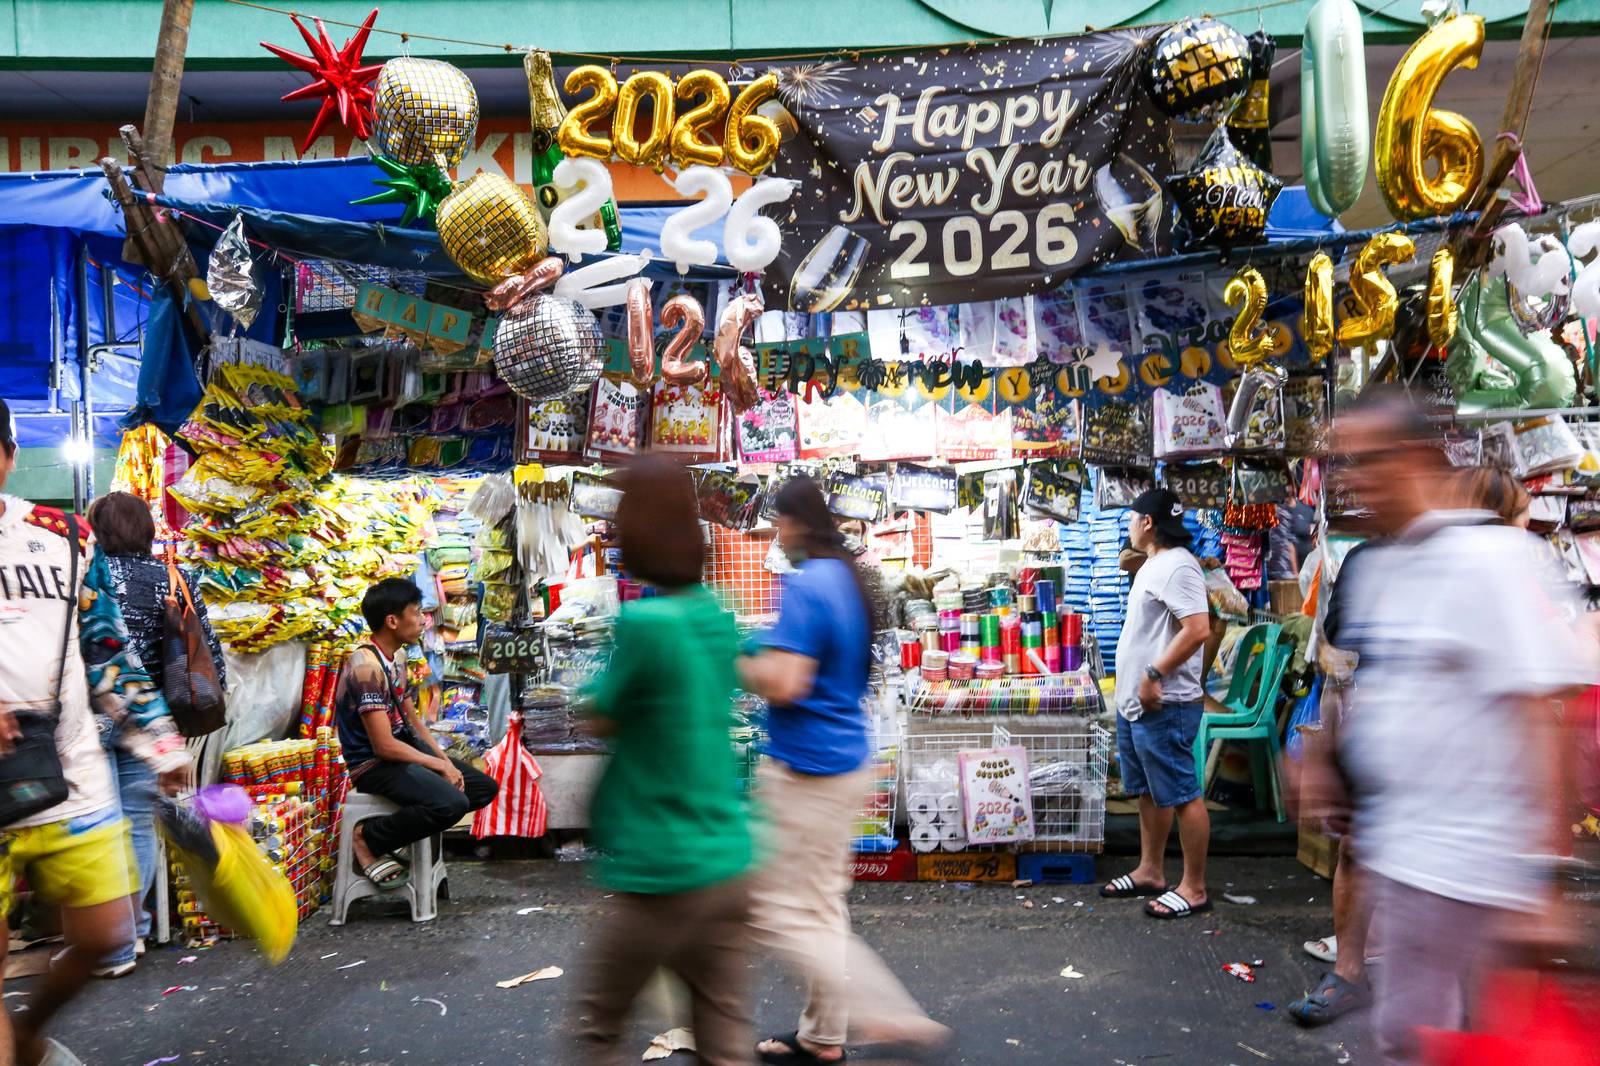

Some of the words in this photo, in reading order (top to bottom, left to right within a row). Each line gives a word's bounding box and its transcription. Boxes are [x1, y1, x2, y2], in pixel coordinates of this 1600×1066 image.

[1168, 39, 1240, 80] NEW
[558, 64, 781, 176] 2026
[872, 86, 1079, 152] Happy
[839, 152, 960, 226] New
[966, 143, 1093, 216] Year
[1204, 165, 1264, 187] HAPPY
[1206, 184, 1264, 209] New
[889, 203, 1079, 279] 2026
[1174, 416, 1206, 426] 2026
[832, 483, 883, 502] WELCOME
[1033, 478, 1077, 505] 2026
[1174, 478, 1219, 495] 2026
[0, 563, 71, 602] TALE
[492, 640, 540, 659] 2026
[977, 802, 1012, 815] 2026
